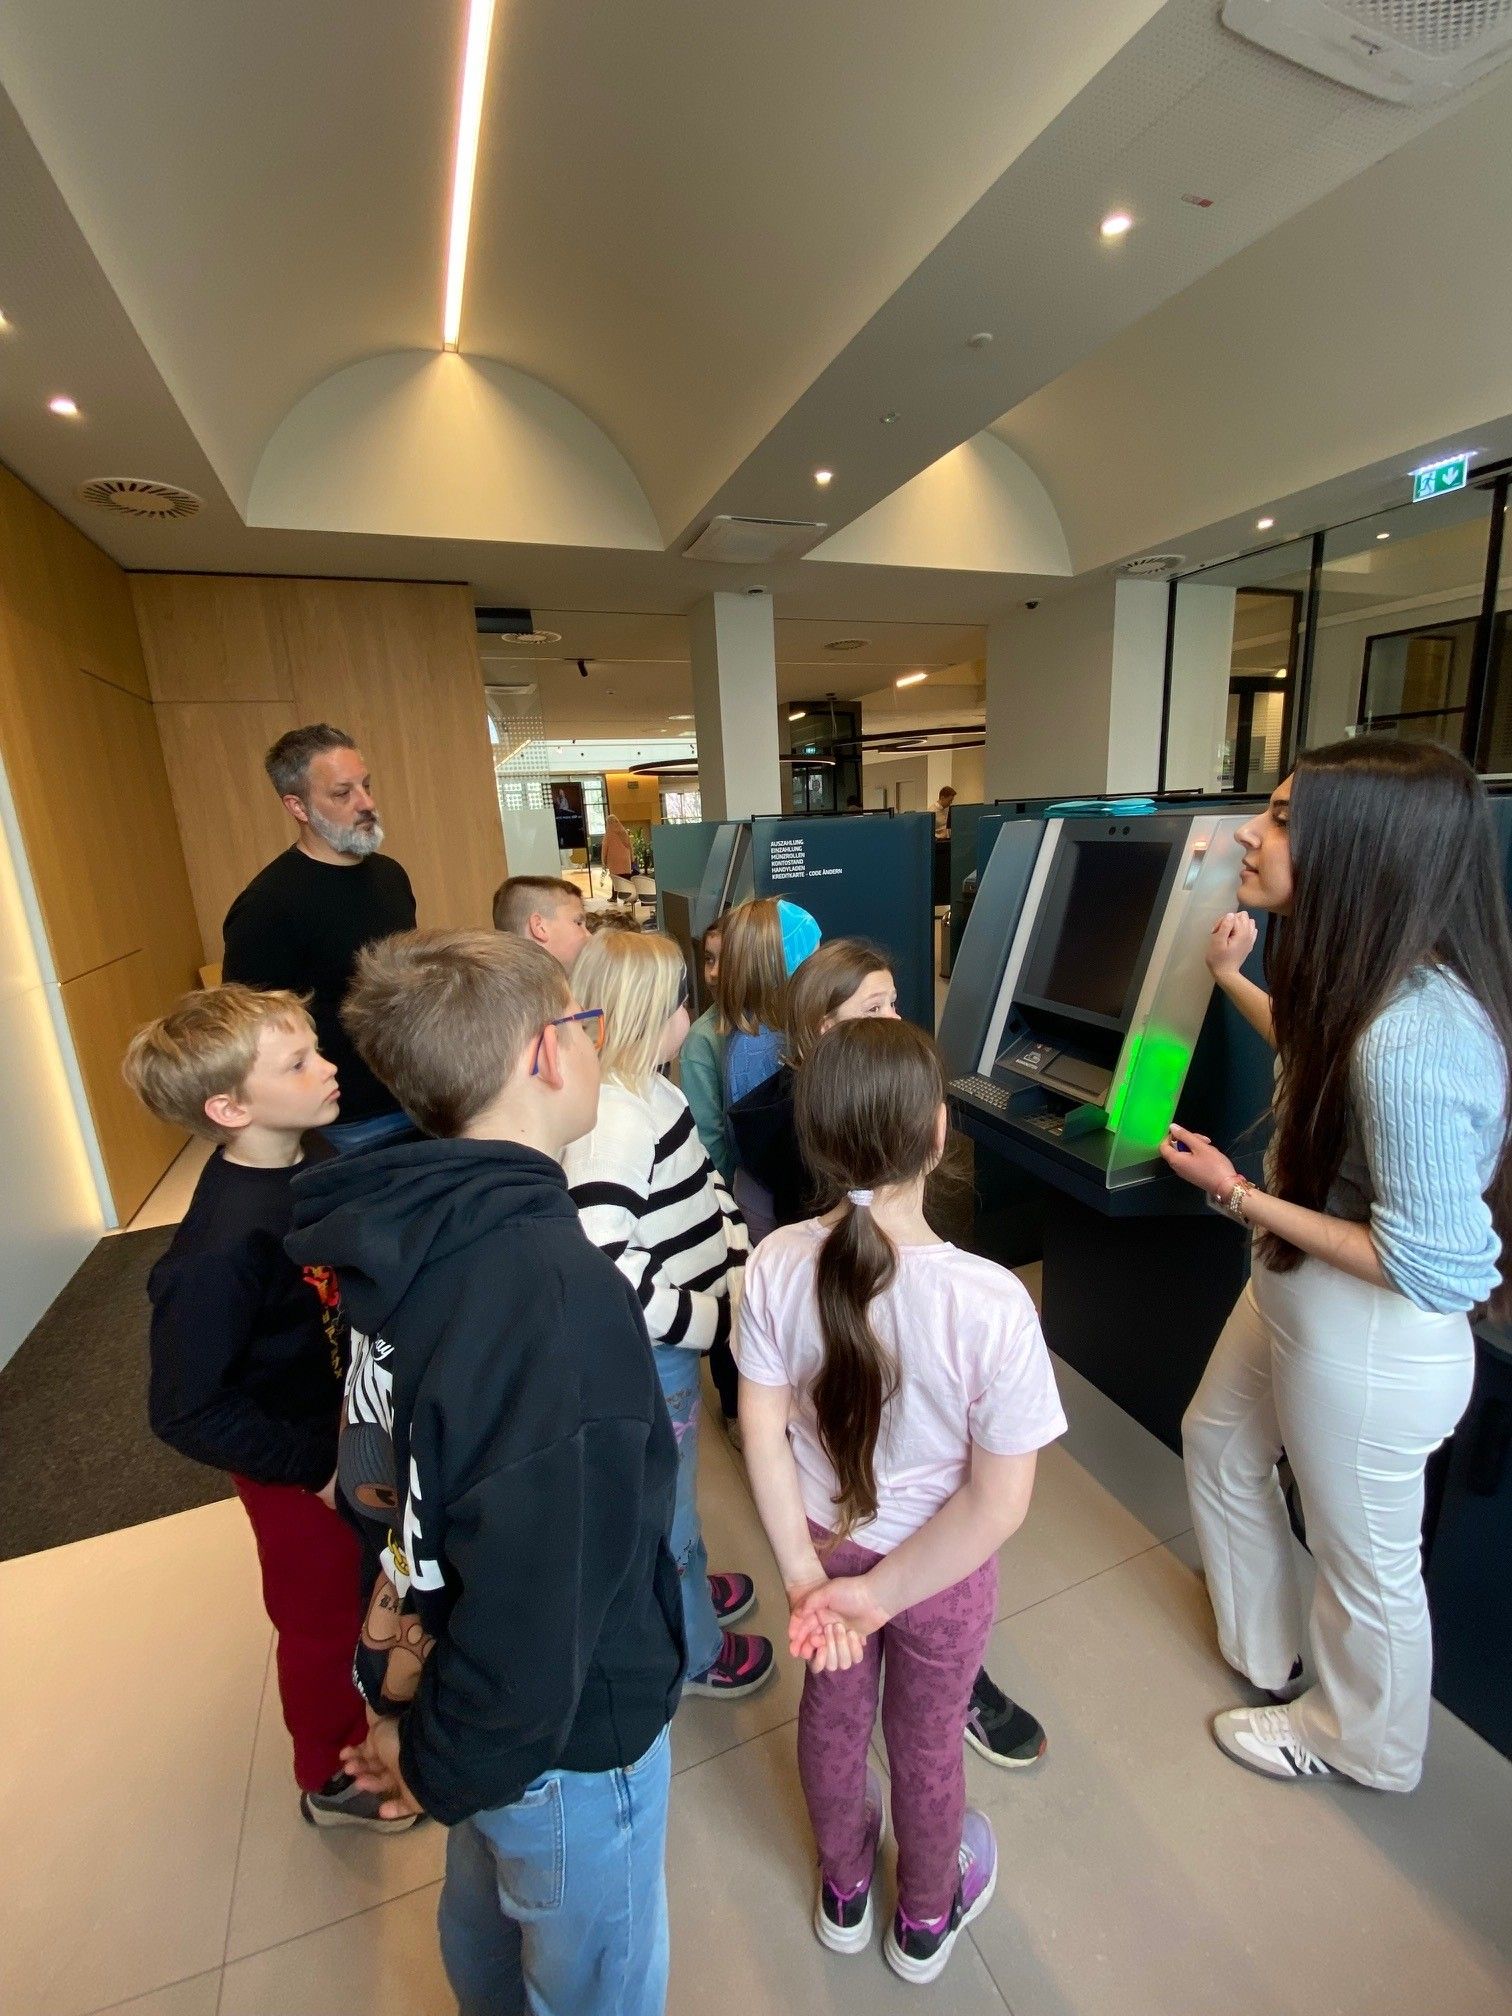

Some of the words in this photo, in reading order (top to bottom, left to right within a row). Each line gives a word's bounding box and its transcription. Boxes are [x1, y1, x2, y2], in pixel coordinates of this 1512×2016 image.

[770, 839, 804, 847] AUSZAHLUNG
[770, 846, 803, 854] EINZAHLUNG
[770, 852, 806, 860] MÜNZROLLEN
[771, 859, 804, 867] KONTOSTAND
[771, 872, 805, 880] KREDITKARTE
